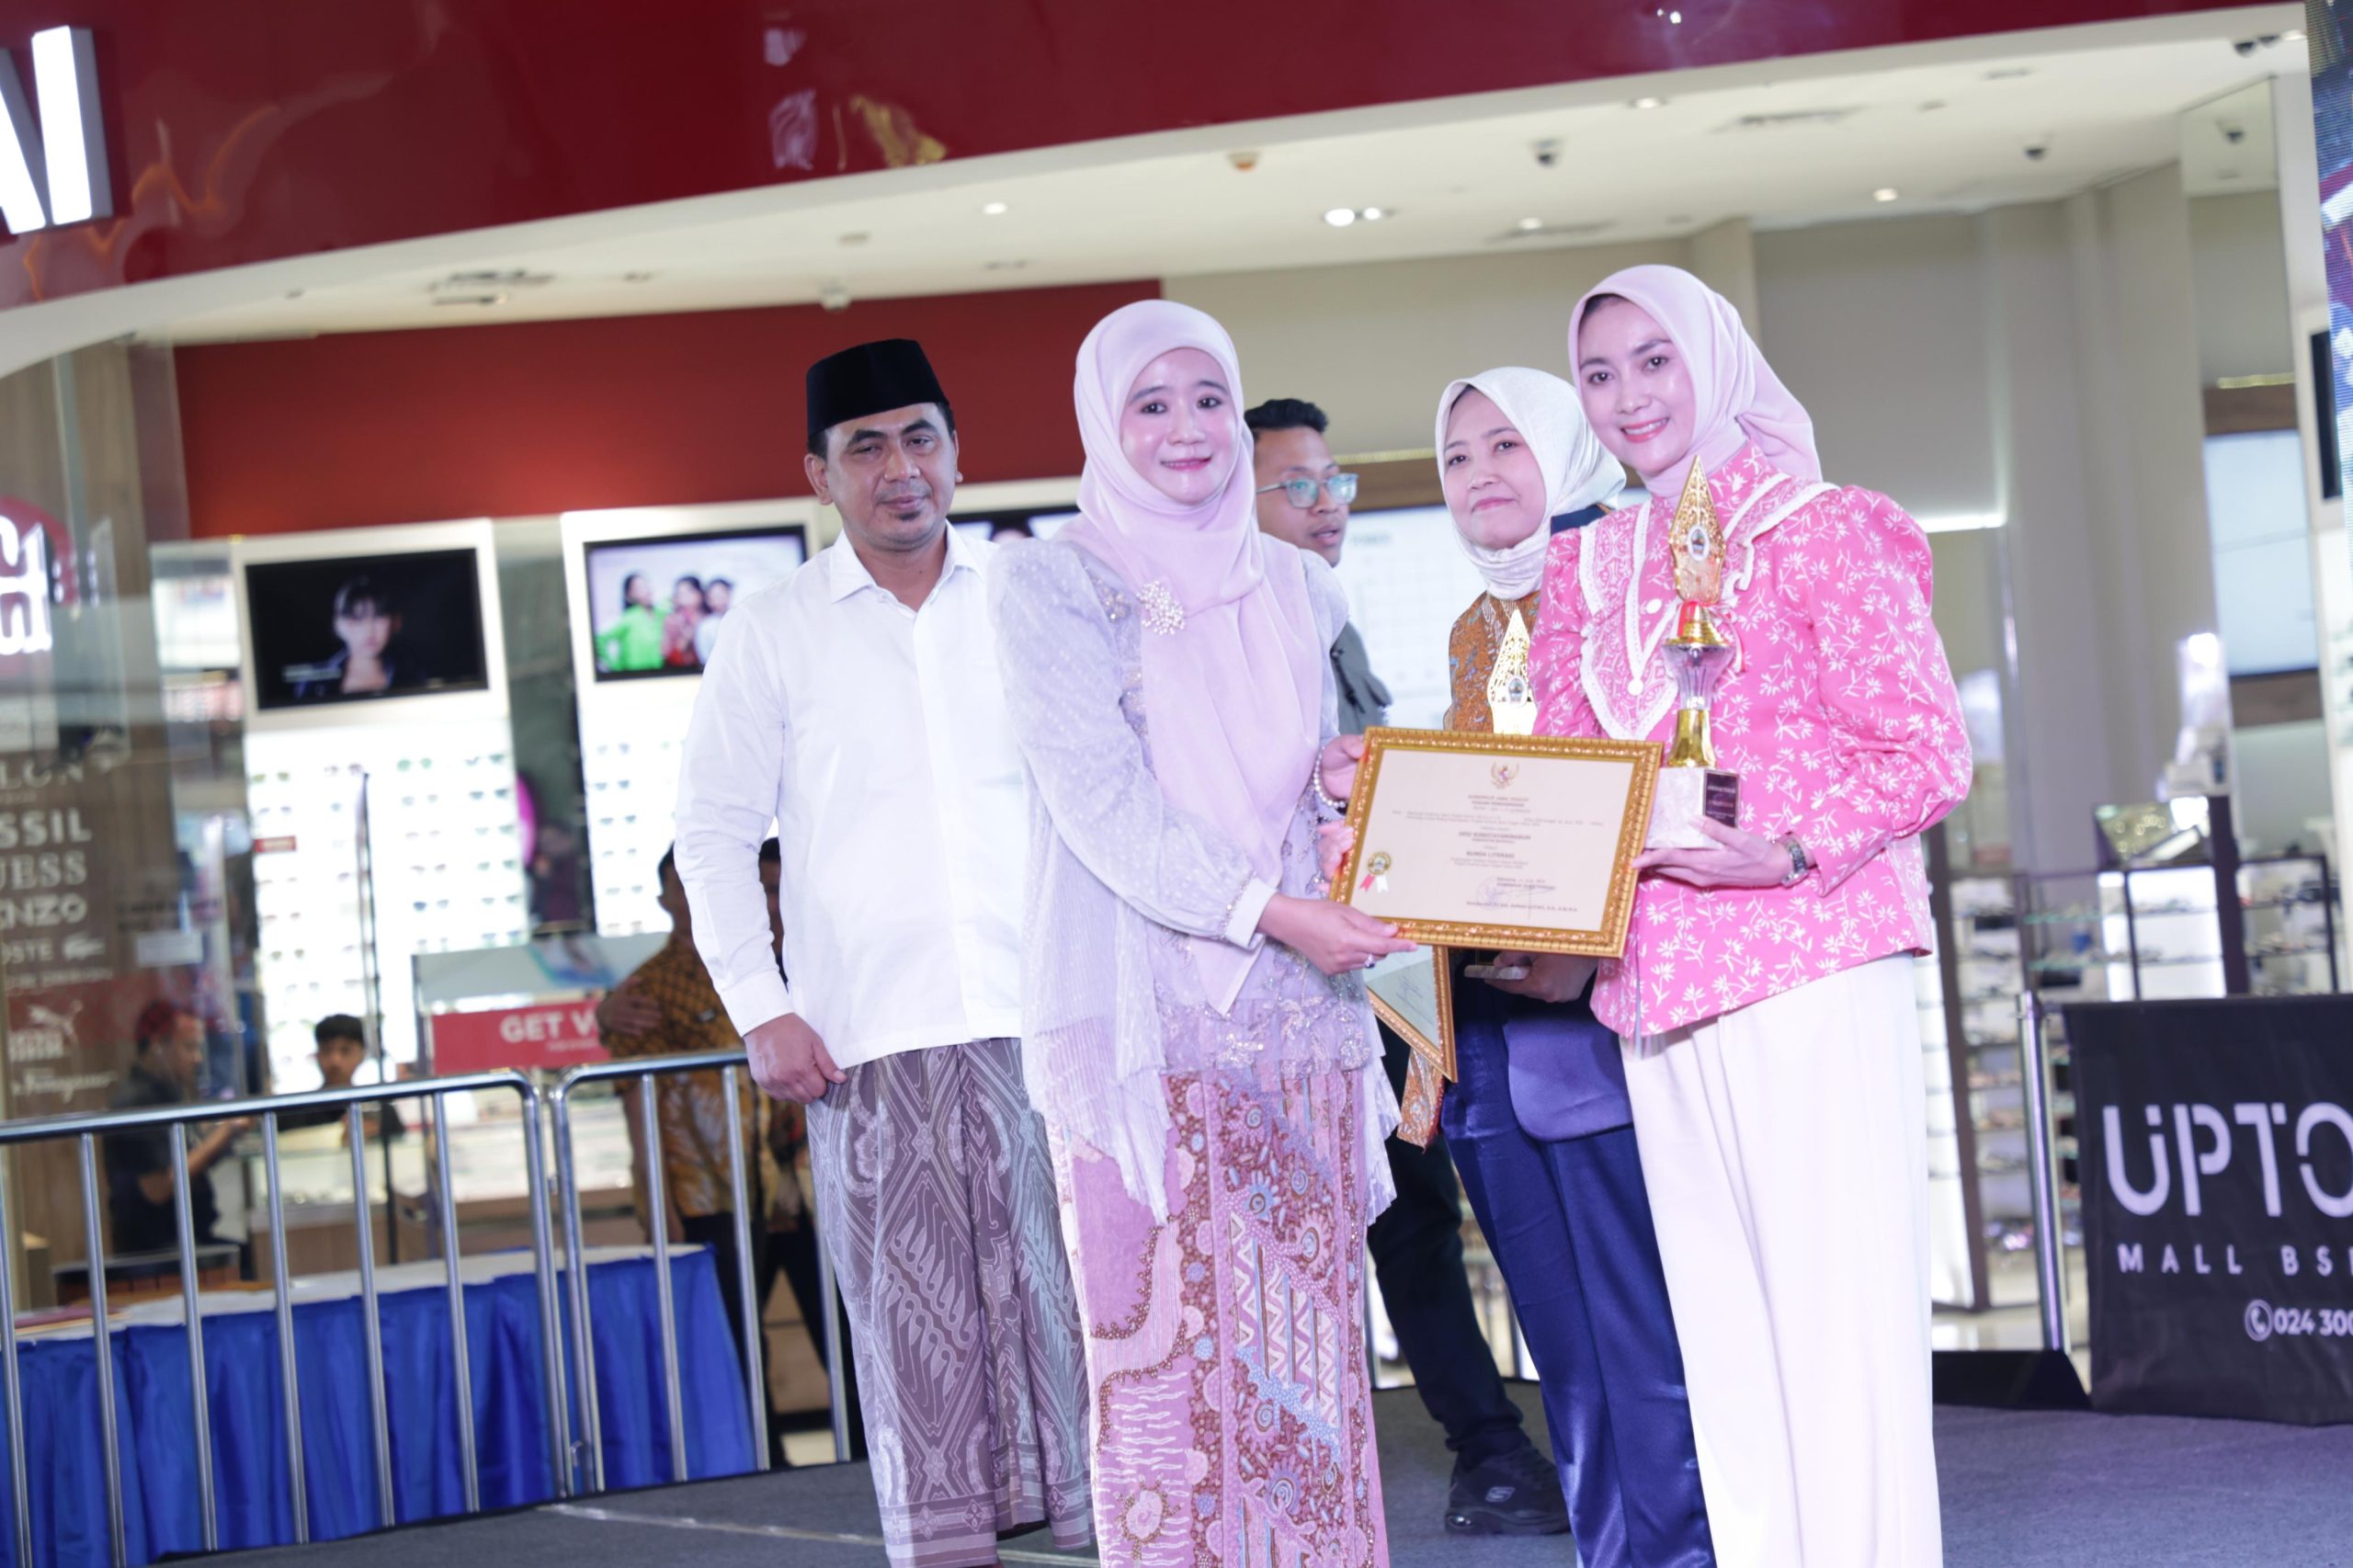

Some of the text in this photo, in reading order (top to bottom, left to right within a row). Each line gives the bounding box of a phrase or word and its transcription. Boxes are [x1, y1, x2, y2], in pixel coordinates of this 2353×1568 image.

[0, 851, 87, 891] ESS
[501, 1014, 563, 1043] GET
[2118, 1244, 2353, 1277] MALL BS
[2274, 1308, 2315, 1335] 024
